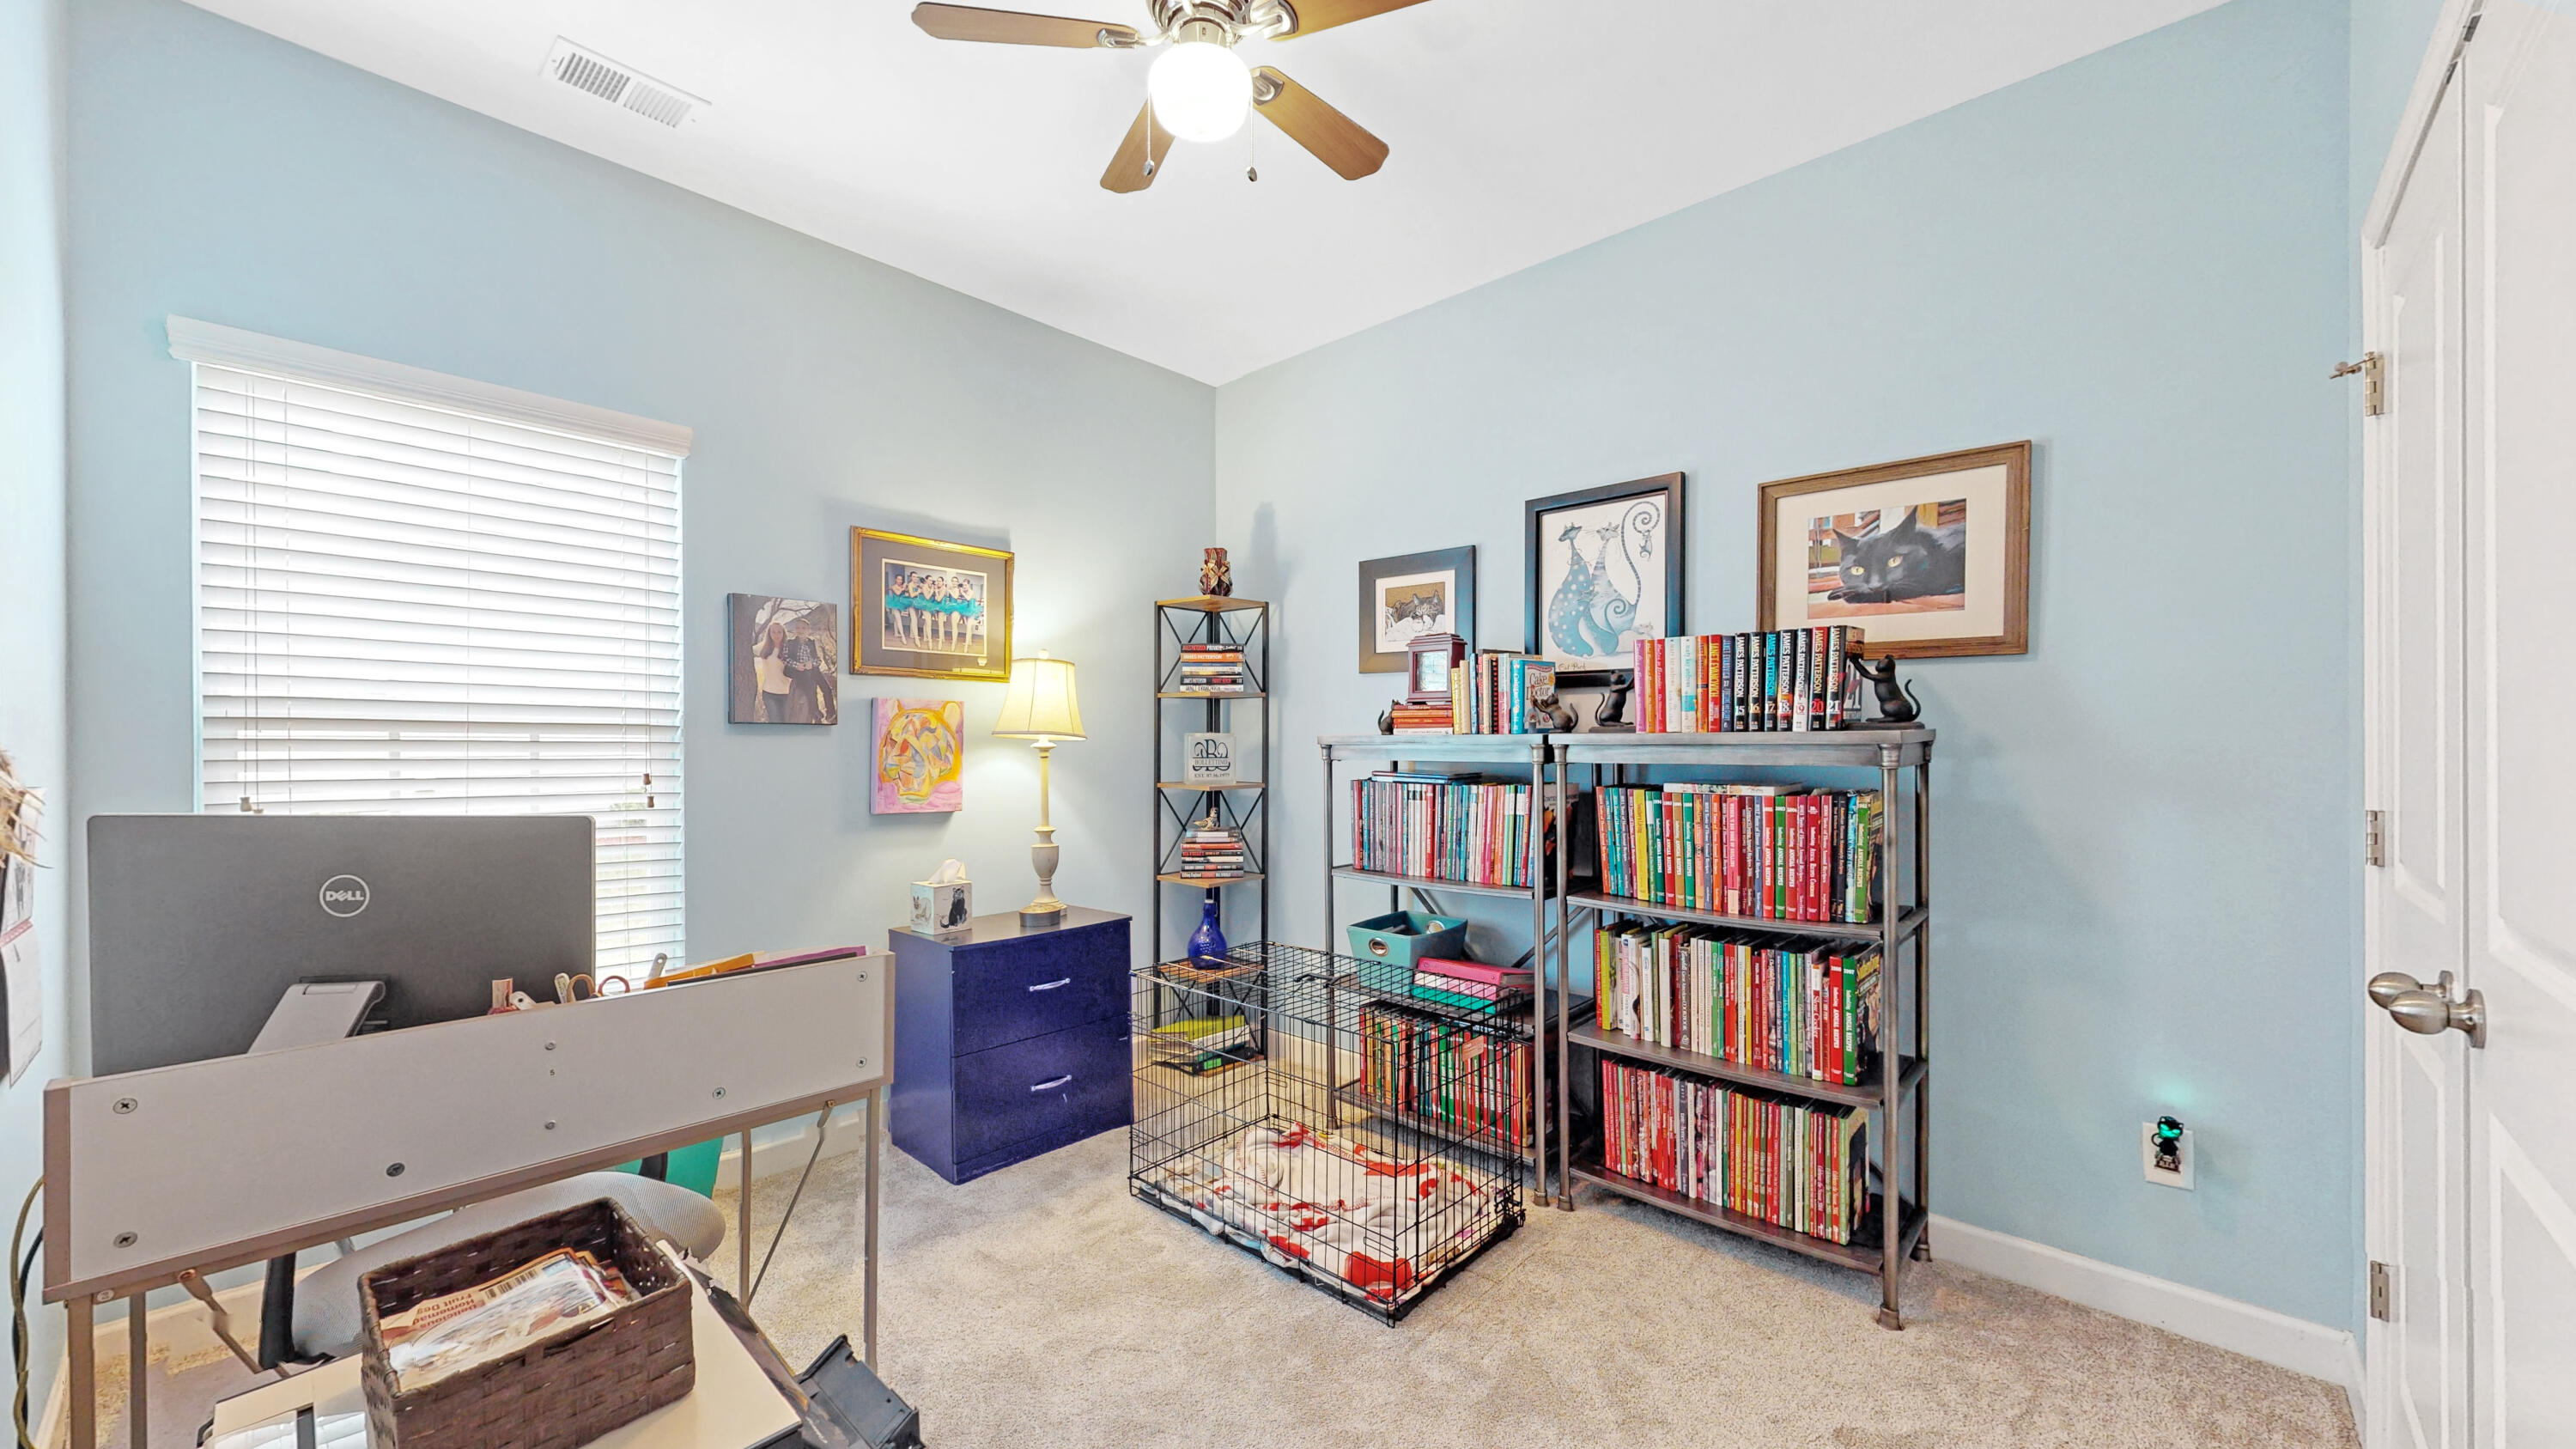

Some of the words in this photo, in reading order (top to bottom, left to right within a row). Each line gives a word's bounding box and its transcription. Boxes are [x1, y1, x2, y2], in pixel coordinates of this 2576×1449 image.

[1735, 636, 1745, 657] JAMES
[1751, 636, 1760, 656] JAMES
[1766, 634, 1777, 655] JAMES
[1782, 633, 1791, 654] JAMES
[1798, 632, 1807, 649] JAMES
[1814, 630, 1824, 652] JAMES
[1831, 628, 1840, 650] JAMES
[1710, 642, 1719, 661] JANET
[1529, 673, 1547, 685] Cake
[1710, 662, 1719, 697] EVANOVICH
[1735, 659, 1745, 697] PATTERSON
[1751, 658, 1759, 697] PATTERSON
[1766, 658, 1776, 696] PATTERSON
[1781, 657, 1791, 694] PATTERSON
[1797, 651, 1806, 691] PATTERSON
[1814, 654, 1823, 693] PATTERSON
[1830, 652, 1839, 692] PATTERSON
[325, 890, 365, 902] DELL
[1813, 995, 1821, 1012] Slow
[444, 1294, 471, 1306] Fruit
[420, 1304, 477, 1329] Delicious
